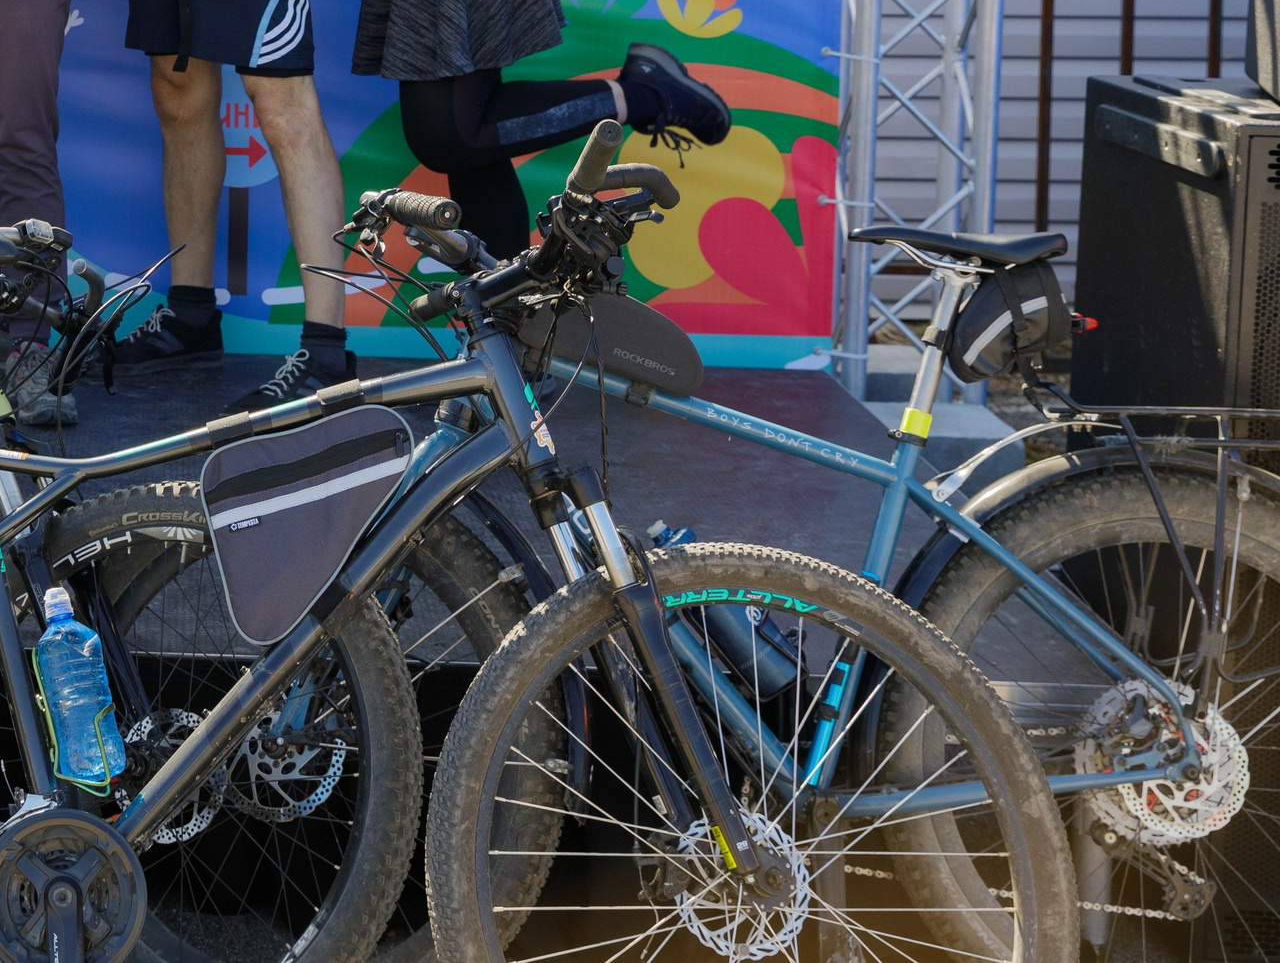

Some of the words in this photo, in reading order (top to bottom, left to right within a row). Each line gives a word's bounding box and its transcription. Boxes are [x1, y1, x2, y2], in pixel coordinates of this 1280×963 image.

[612, 347, 677, 377] ROCKBROS
[705, 407, 753, 431] BOYS
[820, 448, 859, 468] CRY
[236, 517, 260, 530] TEMPESTA
[663, 588, 819, 614] ALLTERR
